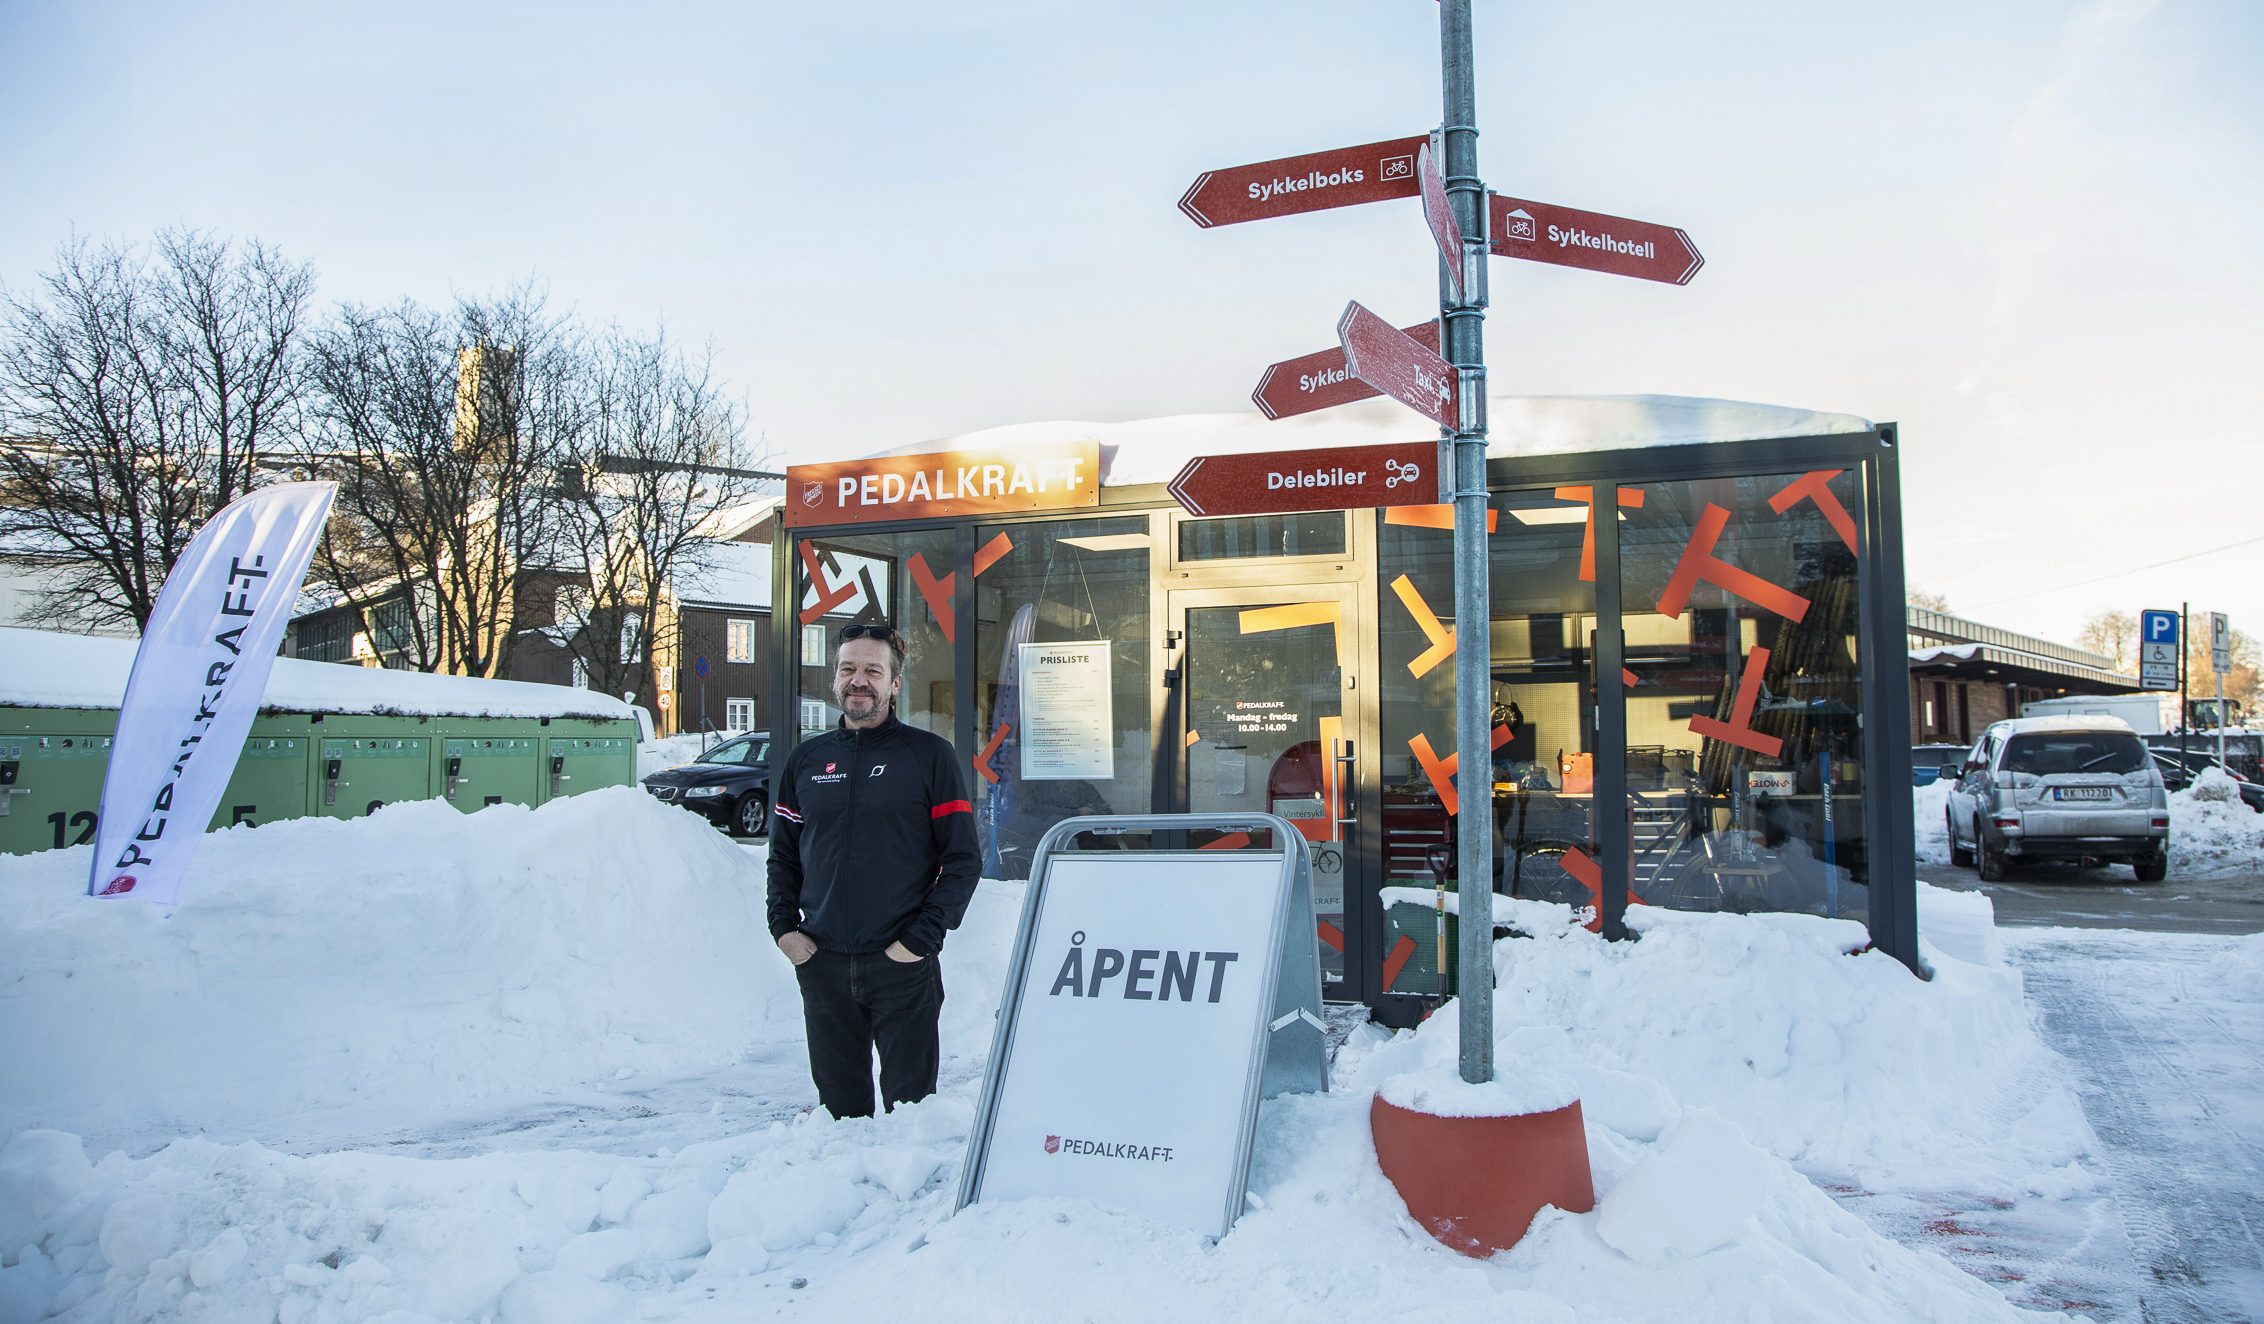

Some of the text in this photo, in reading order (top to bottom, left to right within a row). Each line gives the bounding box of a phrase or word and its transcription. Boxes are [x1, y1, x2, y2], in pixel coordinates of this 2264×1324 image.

[1248, 167, 1364, 201] Sykkelboks
[1548, 225, 1654, 259] Sykkelhotell
[1300, 363, 1356, 393] Sykkel
[1413, 363, 1432, 391] Taxi
[838, 457, 1083, 507] PEDALKRAFT
[1267, 467, 1367, 490] Delebiler
[2152, 616, 2170, 639] P
[2215, 617, 2224, 644] P
[1040, 655, 1089, 664] PRISLISTE
[661, 696, 669, 705] 40
[1243, 701, 1285, 709] PEDALKRAFT
[1227, 713, 1262, 723] Mandag
[1268, 712, 1298, 723] fredag
[811, 773, 847, 781] PEDALKRAFT
[2063, 789, 2075, 797] RK
[48, 811, 98, 849] 12
[1049, 930, 1239, 1004] ÅPENT
[1063, 1139, 1173, 1162] PEDALKRAFT
